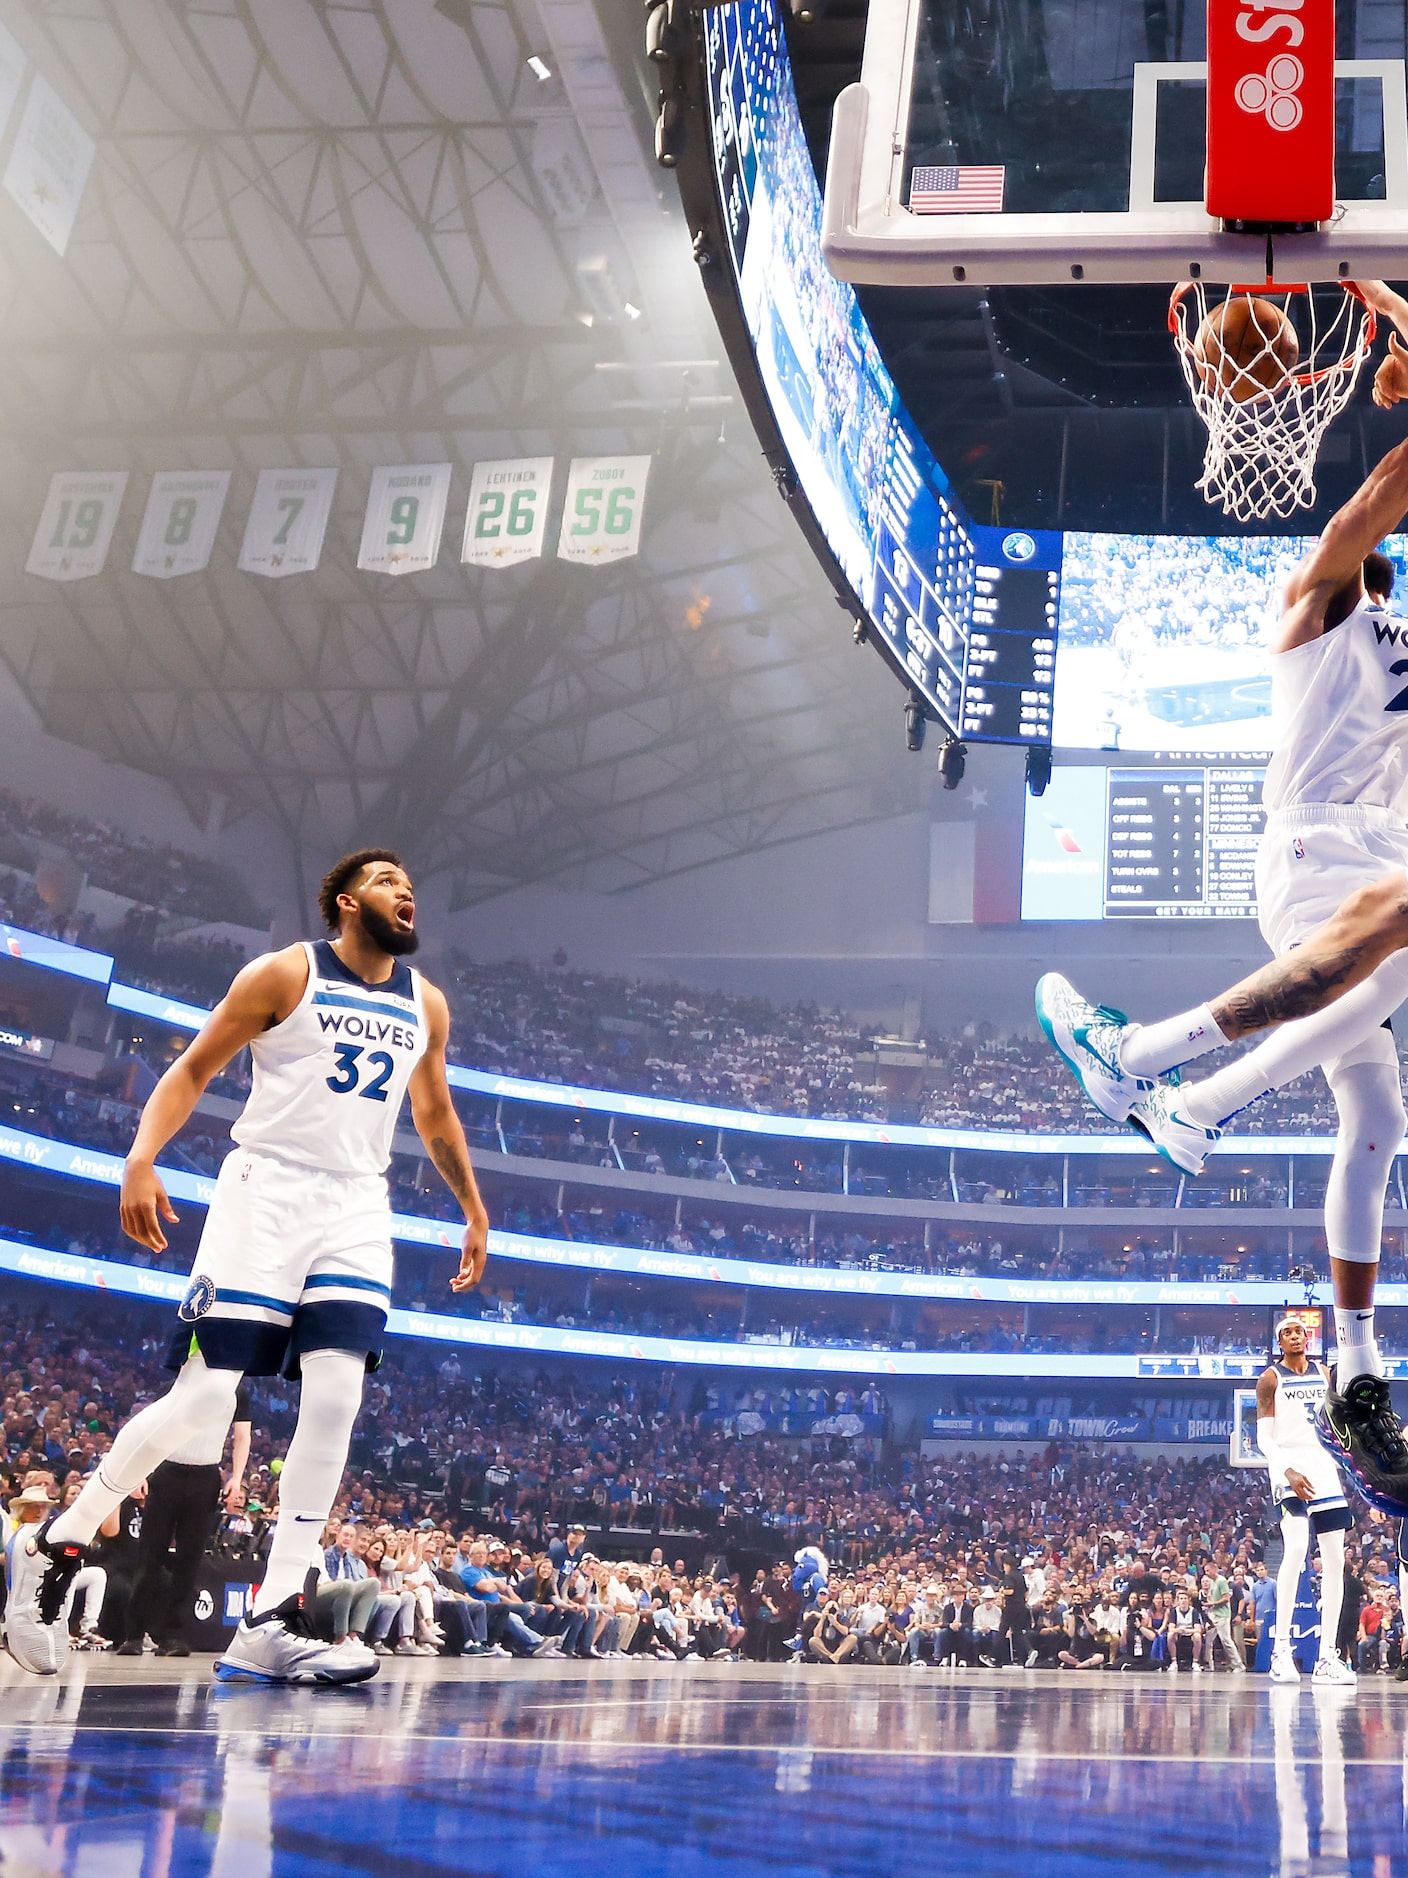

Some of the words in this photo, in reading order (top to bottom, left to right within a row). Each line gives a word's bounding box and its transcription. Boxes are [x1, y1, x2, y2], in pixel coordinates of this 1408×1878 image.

[164, 499, 197, 545] 8
[272, 498, 304, 545] 7
[386, 496, 419, 545] 9
[475, 489, 537, 538] 26
[570, 487, 635, 536] 56
[50, 500, 104, 548] 19
[975, 580, 992, 593] TO
[1049, 587, 1056, 598] 1
[972, 611, 994, 624] STL
[1047, 616, 1055, 627] 1
[968, 665, 984, 677] FT
[964, 717, 980, 730] FT
[1110, 885, 1142, 894] STEALS
[1181, 906, 1211, 916] YOUR
[1215, 906, 1246, 916] MAVS
[317, 1012, 414, 1051] WOLVES
[325, 1042, 394, 1102] 32
[70, 1155, 124, 1180] Americ
[508, 1241, 532, 1257] are
[535, 1242, 567, 1262] why
[569, 1248, 591, 1263] we
[18, 1252, 86, 1279] American
[637, 1257, 701, 1275] American
[748, 1268, 776, 1284] You
[803, 1273, 832, 1292] why
[901, 1278, 963, 1295] American
[1008, 1285, 1034, 1299] You
[1064, 1288, 1094, 1305] why
[1158, 1287, 1219, 1301] American
